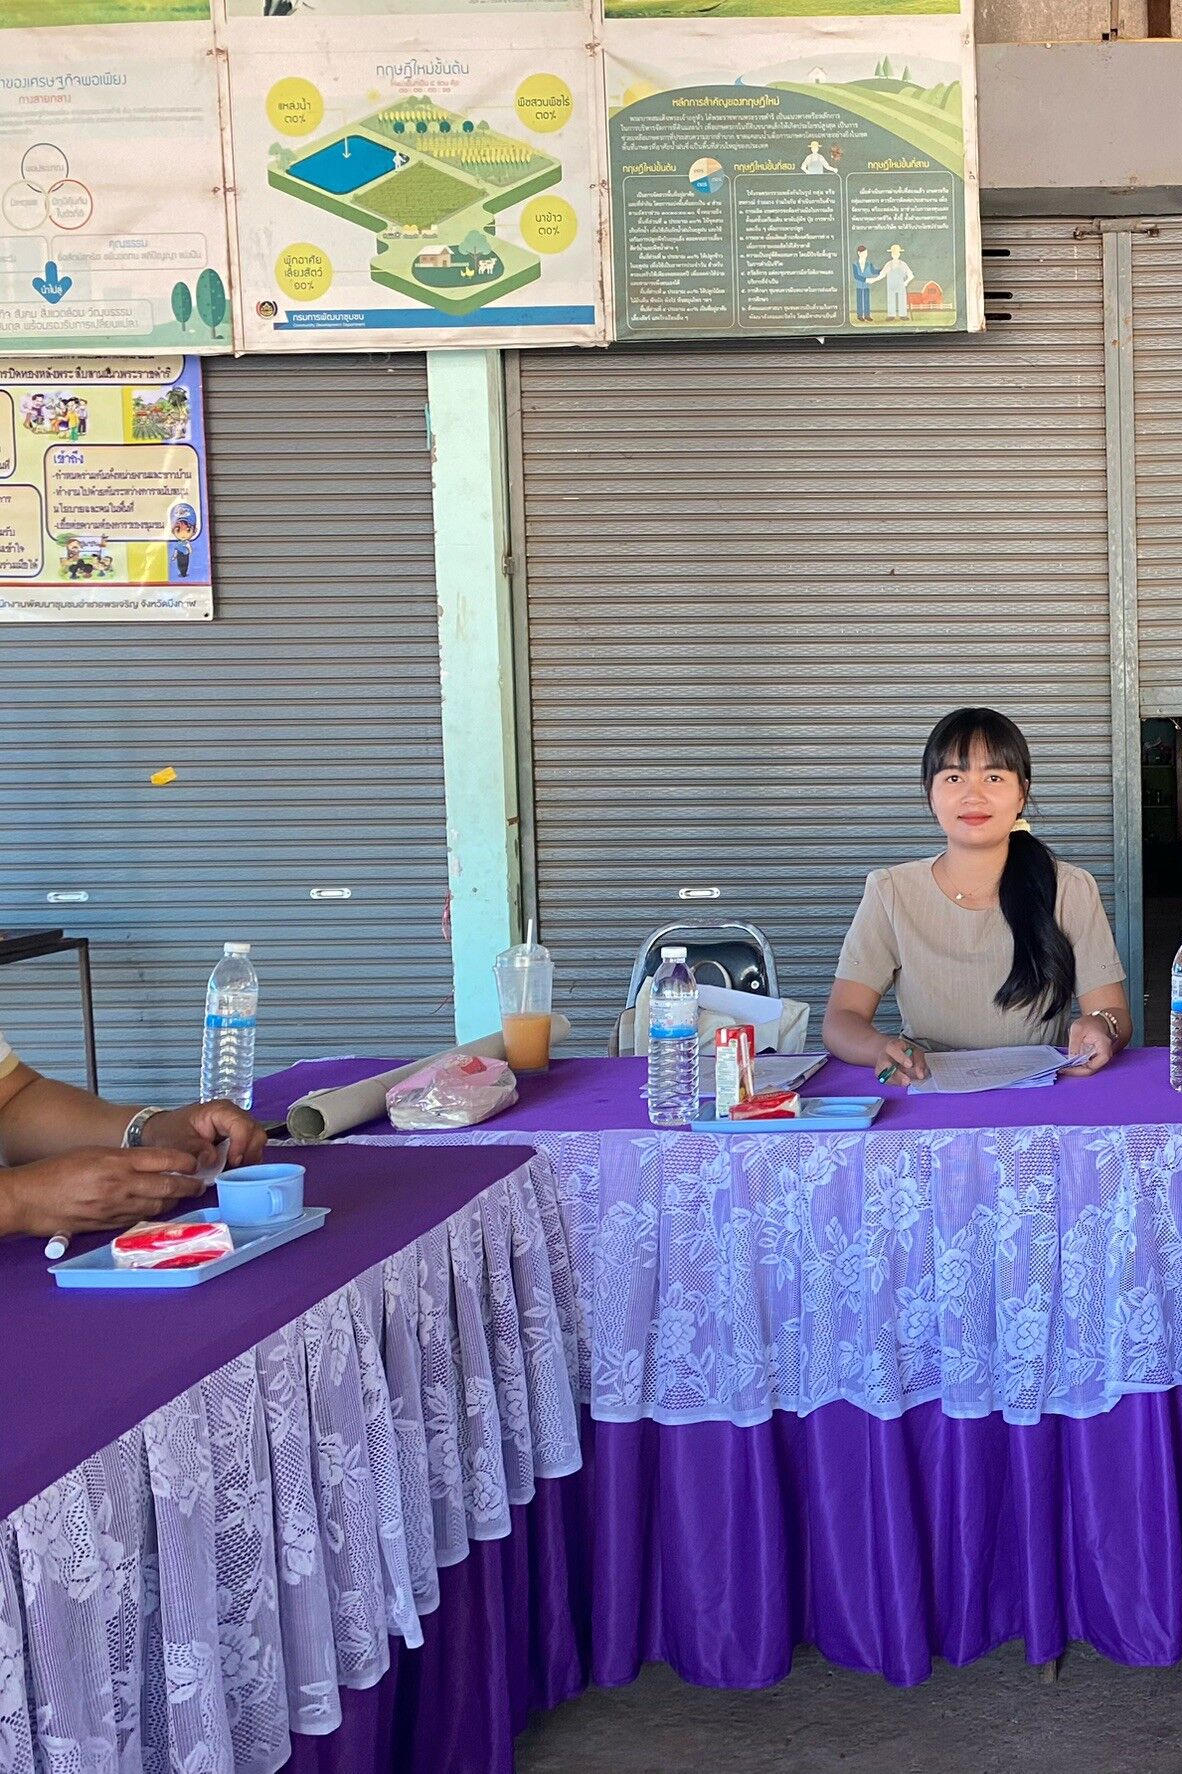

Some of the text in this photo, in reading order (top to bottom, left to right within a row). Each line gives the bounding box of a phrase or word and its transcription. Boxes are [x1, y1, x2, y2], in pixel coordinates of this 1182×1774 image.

[376, 57, 469, 79] ทฤษฎีใหม่ขั้นต้น
[278, 98, 311, 111] แหล่งน้ำ
[517, 94, 571, 107] พืชสวนพืชไร่
[535, 212, 563, 223] นาข้าว
[292, 313, 364, 322] กรมการพัฒนาชุมชน
[54, 450, 84, 464] เข้าถึง
